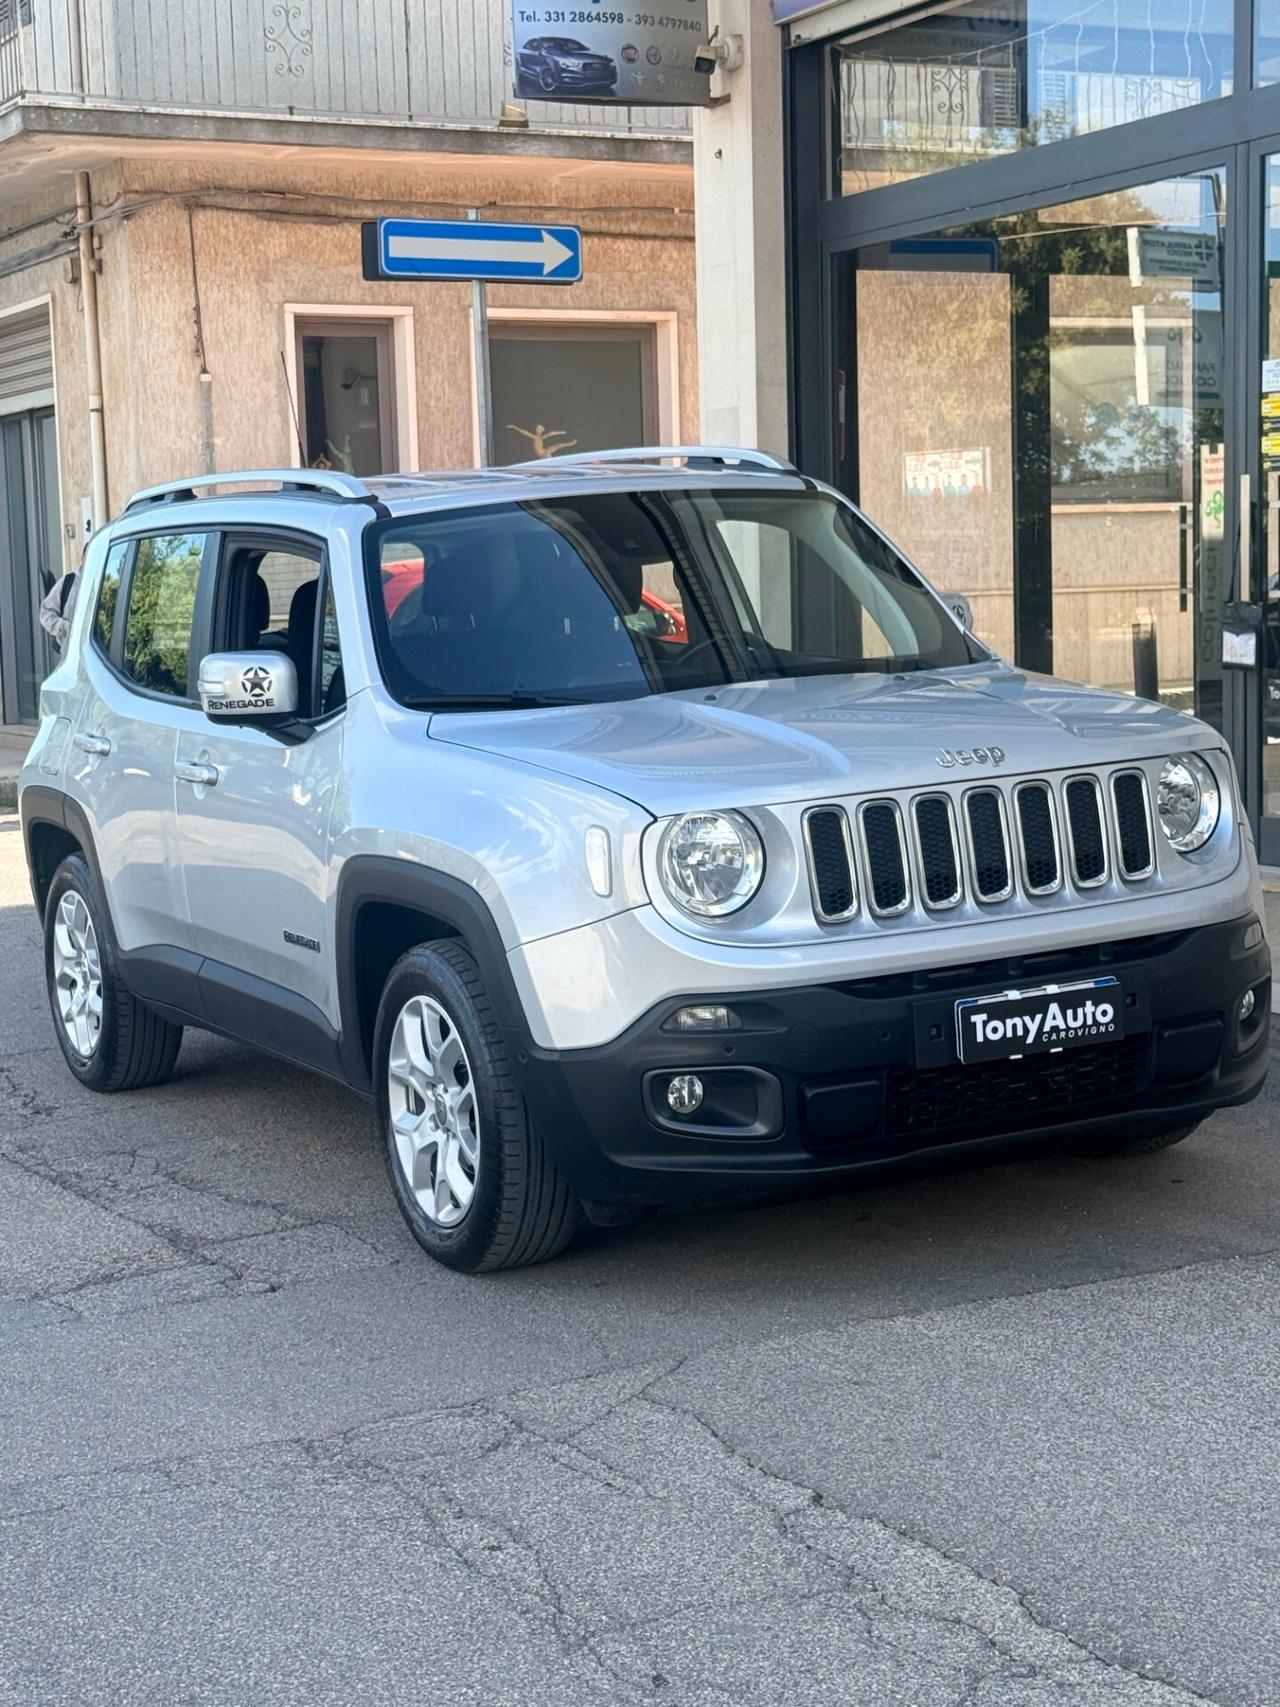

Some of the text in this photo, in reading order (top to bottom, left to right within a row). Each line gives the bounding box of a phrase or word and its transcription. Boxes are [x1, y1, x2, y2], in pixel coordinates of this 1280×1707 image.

[519, 10, 541, 23] Tel.
[544, 10, 565, 24] 331
[569, 11, 624, 25] 2864598
[635, 14, 656, 27] 393
[658, 17, 702, 33] 4797840
[207, 698, 275, 710] RENEGADE
[935, 746, 1005, 769] Jeep
[970, 1000, 1114, 1044] TonyAuto
[1042, 1023, 1115, 1042] CAROVIGNO
